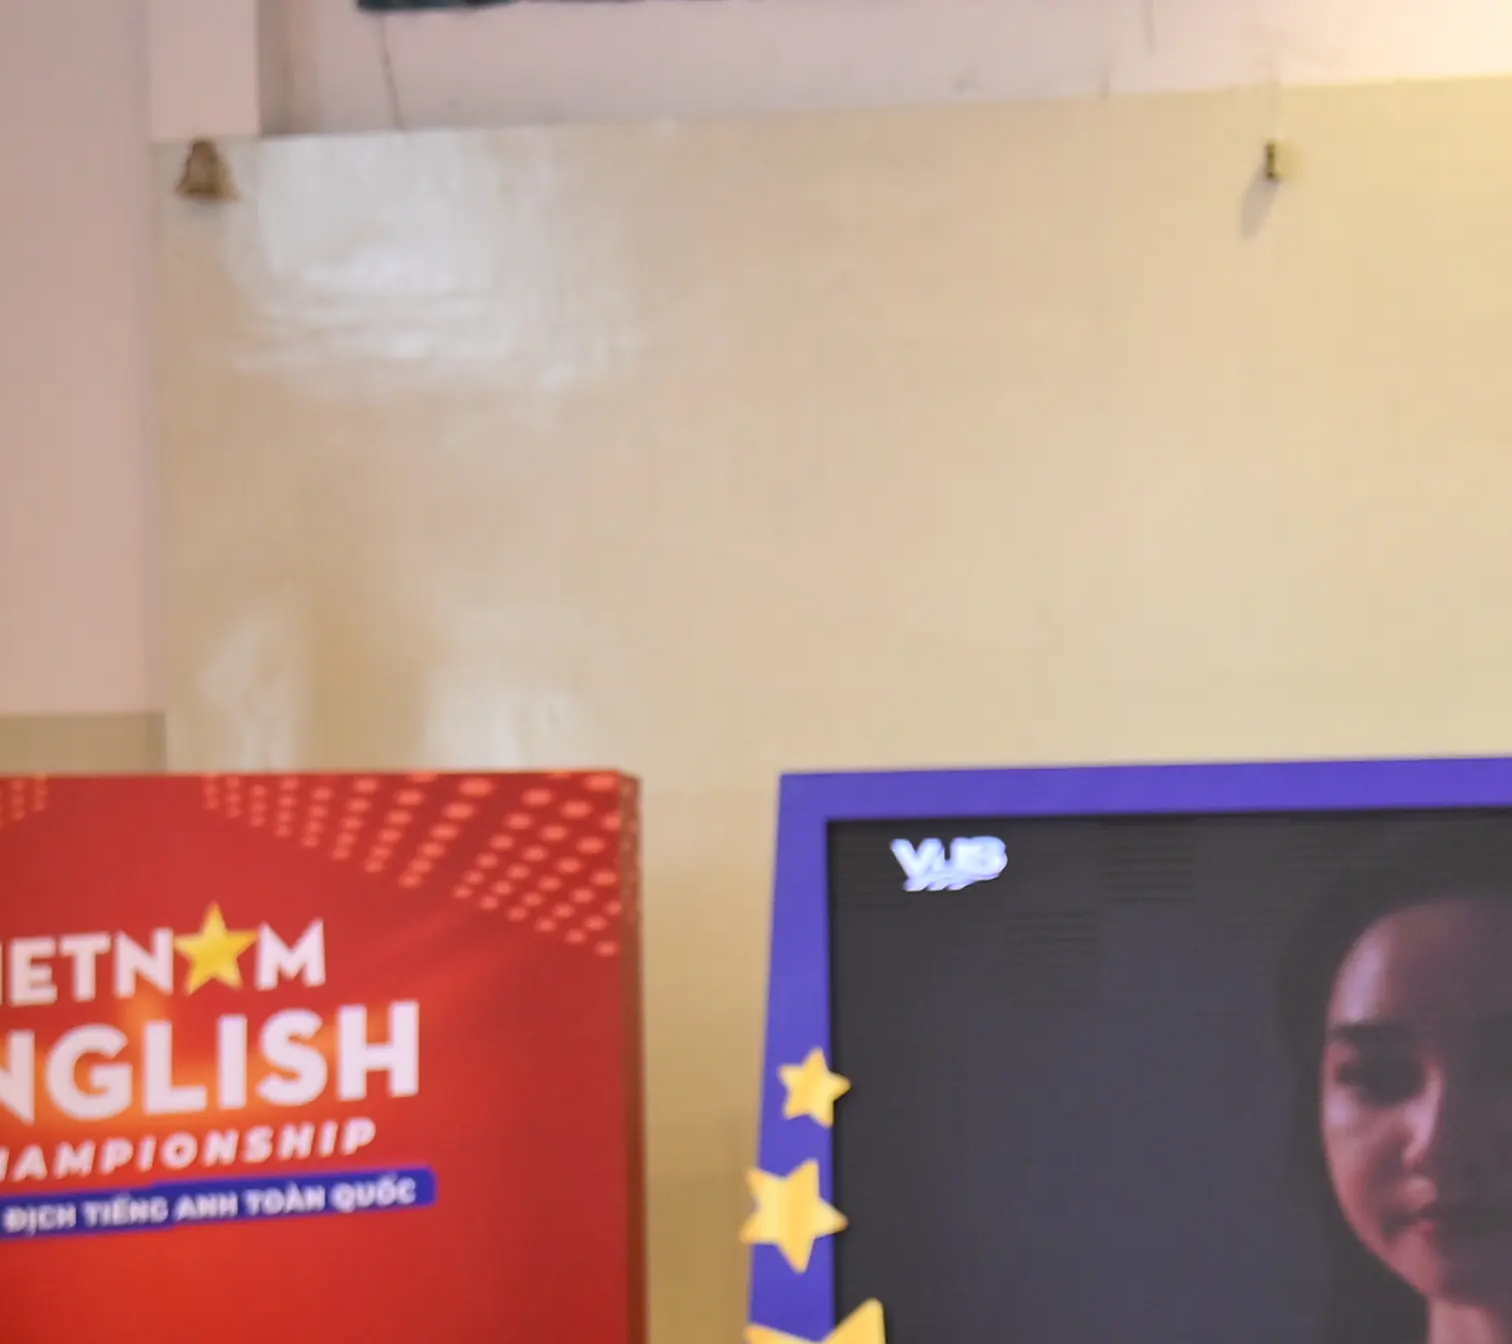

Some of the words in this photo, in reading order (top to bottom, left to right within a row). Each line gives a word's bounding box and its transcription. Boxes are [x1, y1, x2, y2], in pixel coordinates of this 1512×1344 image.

[0, 1195, 75, 1236] ĐỊCH
[82, 1183, 169, 1227] TIẾNG
[177, 1187, 241, 1220] ANH
[245, 1177, 325, 1216] TOÀN
[330, 1169, 417, 1209] QUỐC
